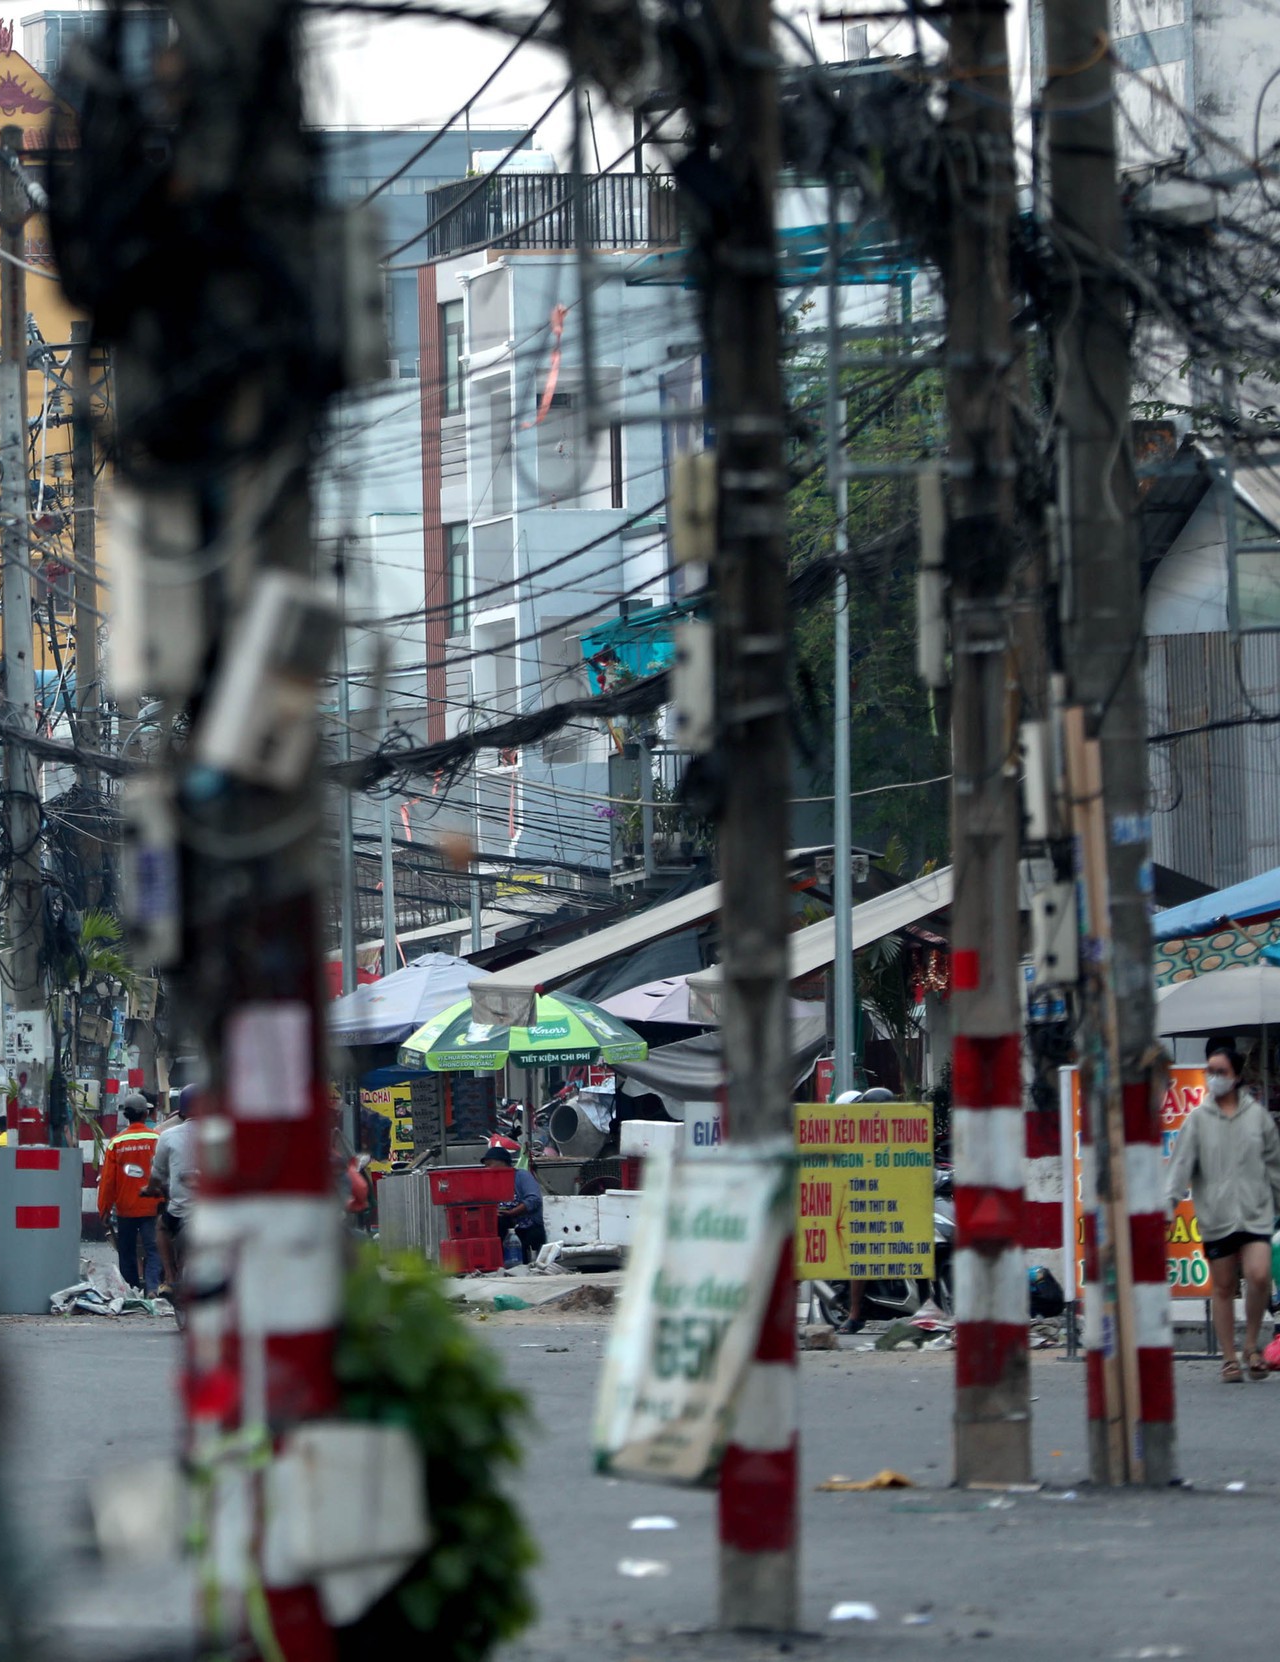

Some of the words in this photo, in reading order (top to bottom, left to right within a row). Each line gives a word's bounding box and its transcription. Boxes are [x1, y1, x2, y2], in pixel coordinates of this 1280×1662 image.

[528, 1025, 568, 1035] Knorr
[520, 1053, 538, 1063] TIẾT
[538, 1052, 559, 1063] KIỆM
[560, 1053, 574, 1061] CHI
[576, 1052, 591, 1060] PHÍ
[694, 1116, 721, 1151] GIẶ
[800, 1113, 831, 1144] BÁNH
[834, 1113, 856, 1144] XÈO
[891, 1118, 928, 1144] TRUNG
[802, 1152, 829, 1168] HƠM
[832, 1152, 864, 1168] NGON
[893, 1149, 932, 1168] DƯỠNG
[868, 1179, 879, 1191] 6K
[800, 1175, 832, 1217] BÁNH
[869, 1200, 885, 1215] THỊT
[887, 1200, 898, 1212] 8K
[890, 1221, 904, 1233] 10K
[869, 1242, 885, 1257] THỊT
[887, 1240, 914, 1255] TRỨNG
[917, 1242, 931, 1254] 10K
[908, 1263, 924, 1275] 12K
